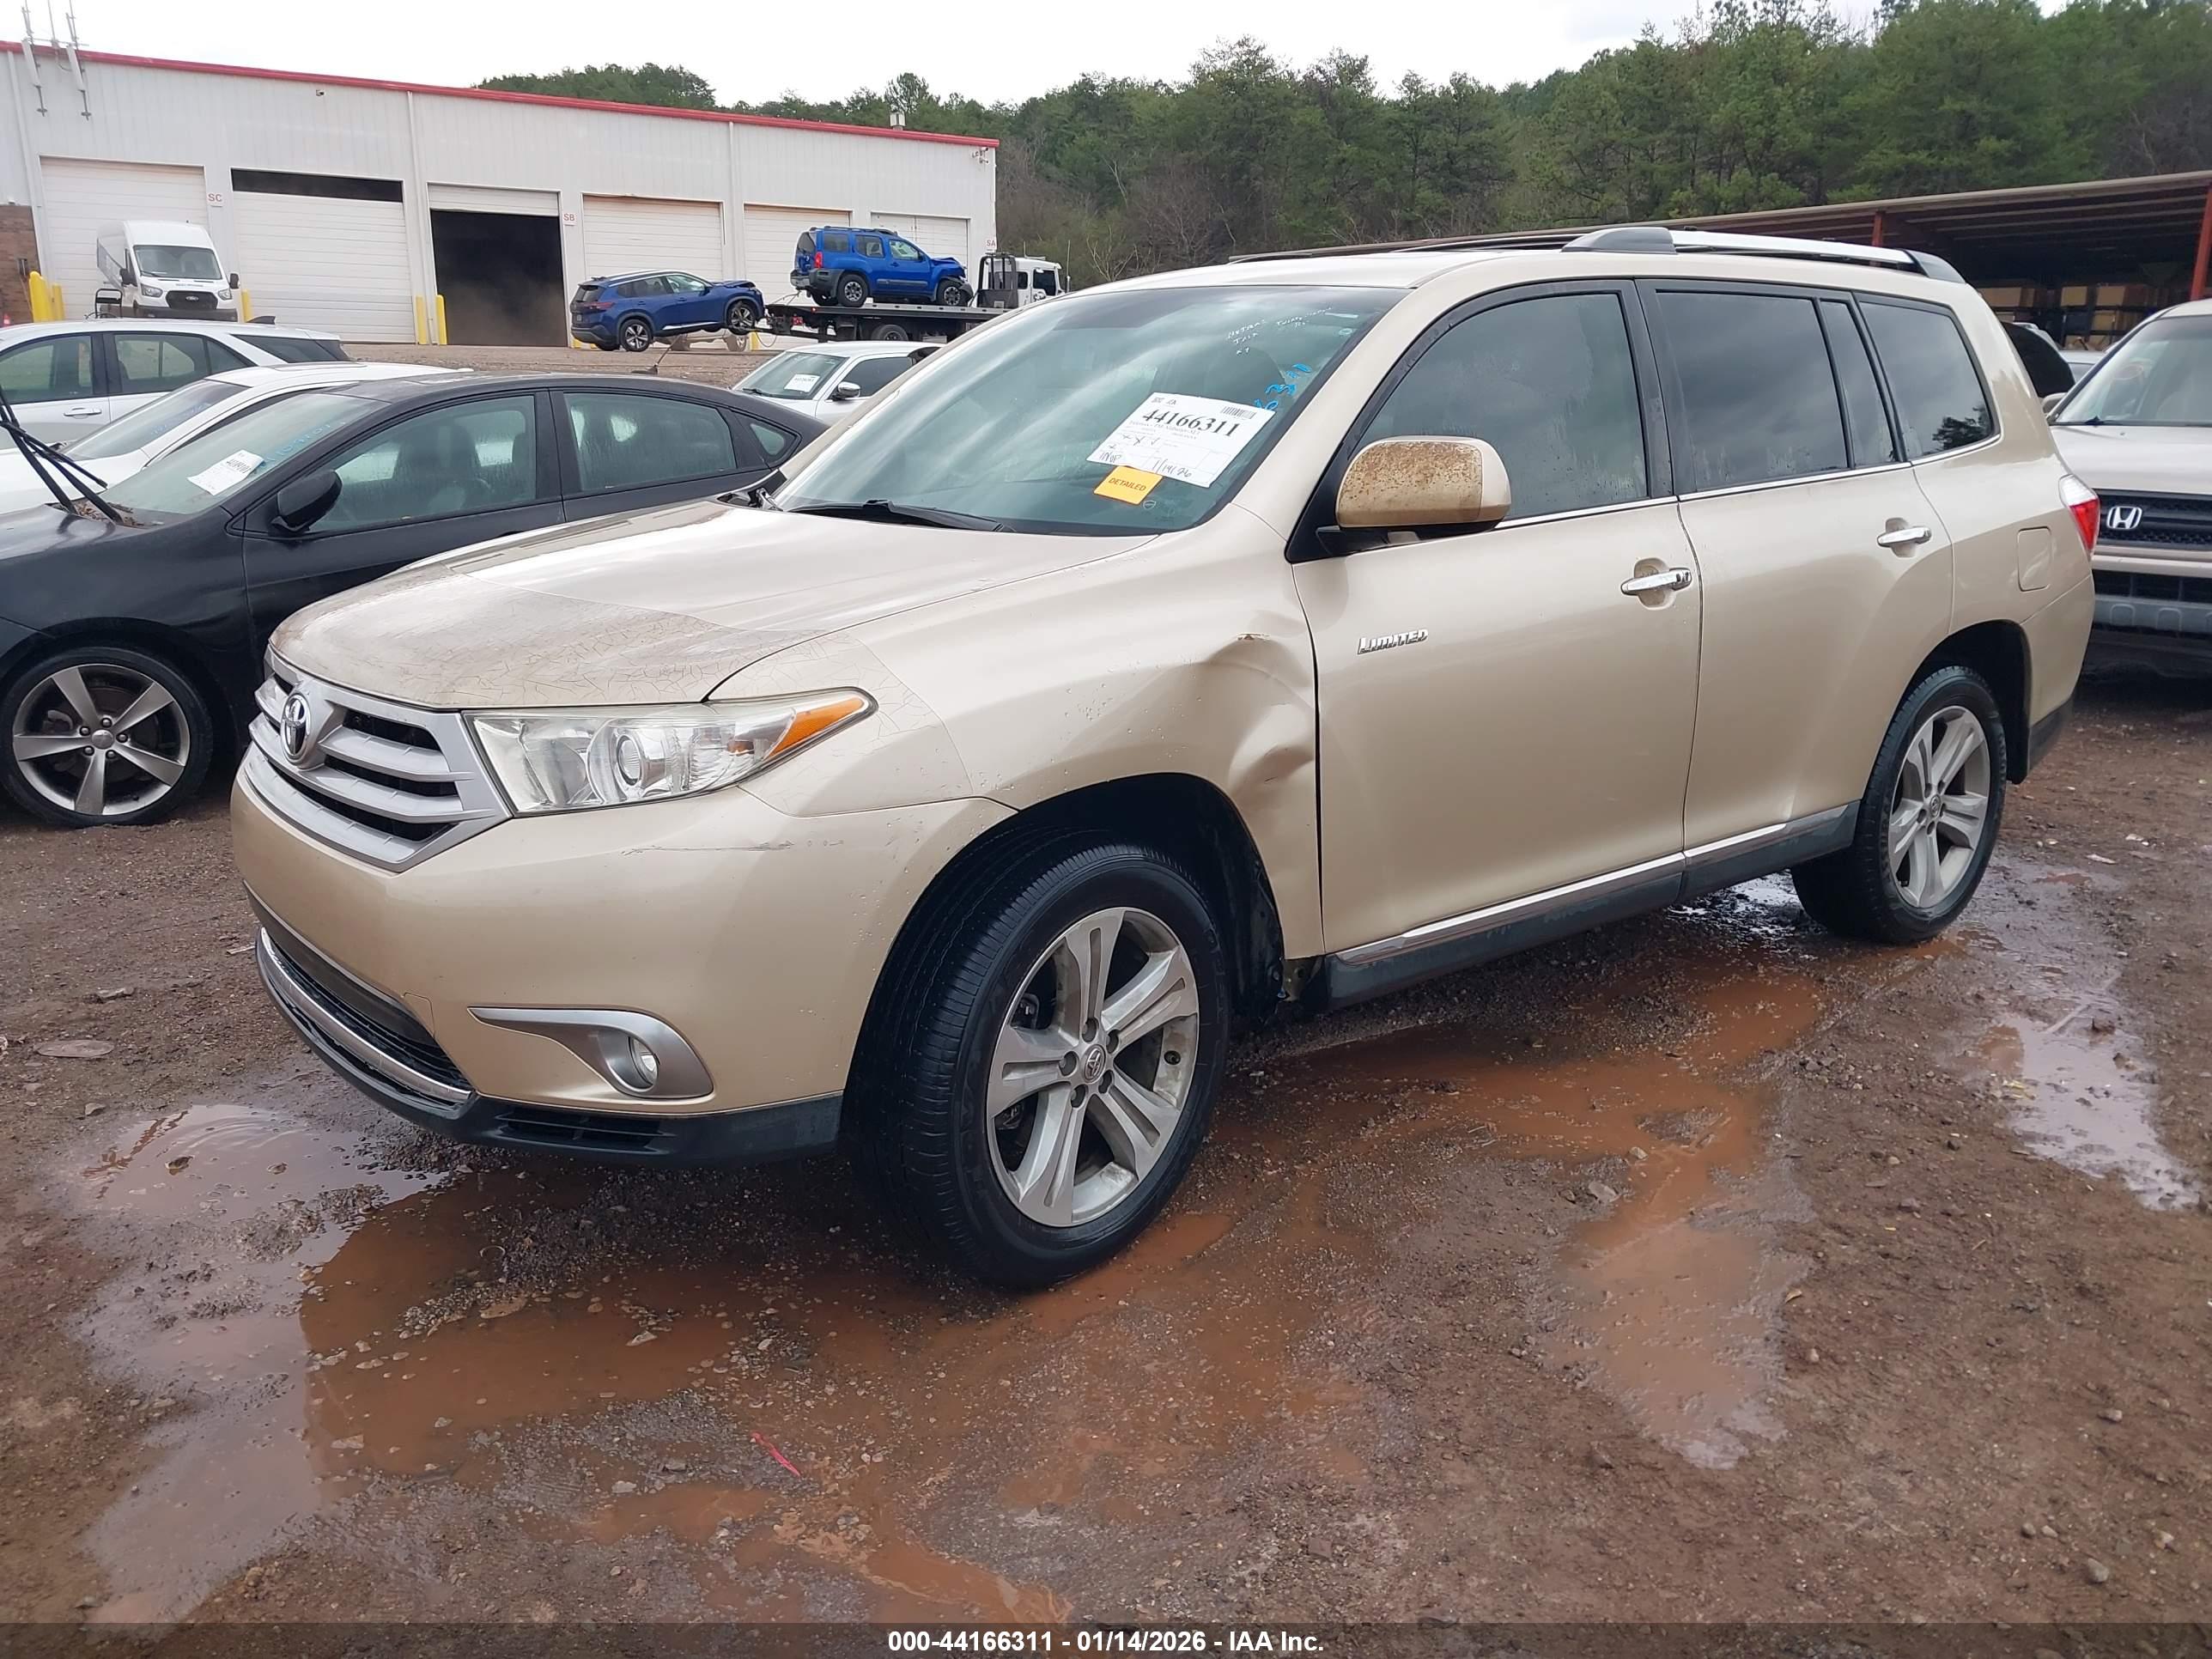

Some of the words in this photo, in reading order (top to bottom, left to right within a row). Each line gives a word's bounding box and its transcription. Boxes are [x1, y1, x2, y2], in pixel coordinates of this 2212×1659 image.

[208, 193, 222, 202] SC
[563, 213, 575, 222] SB
[1142, 409, 1241, 437] 44166311
[1109, 477, 1146, 491] DETAILED
[1358, 629, 1429, 655] LIMITED
